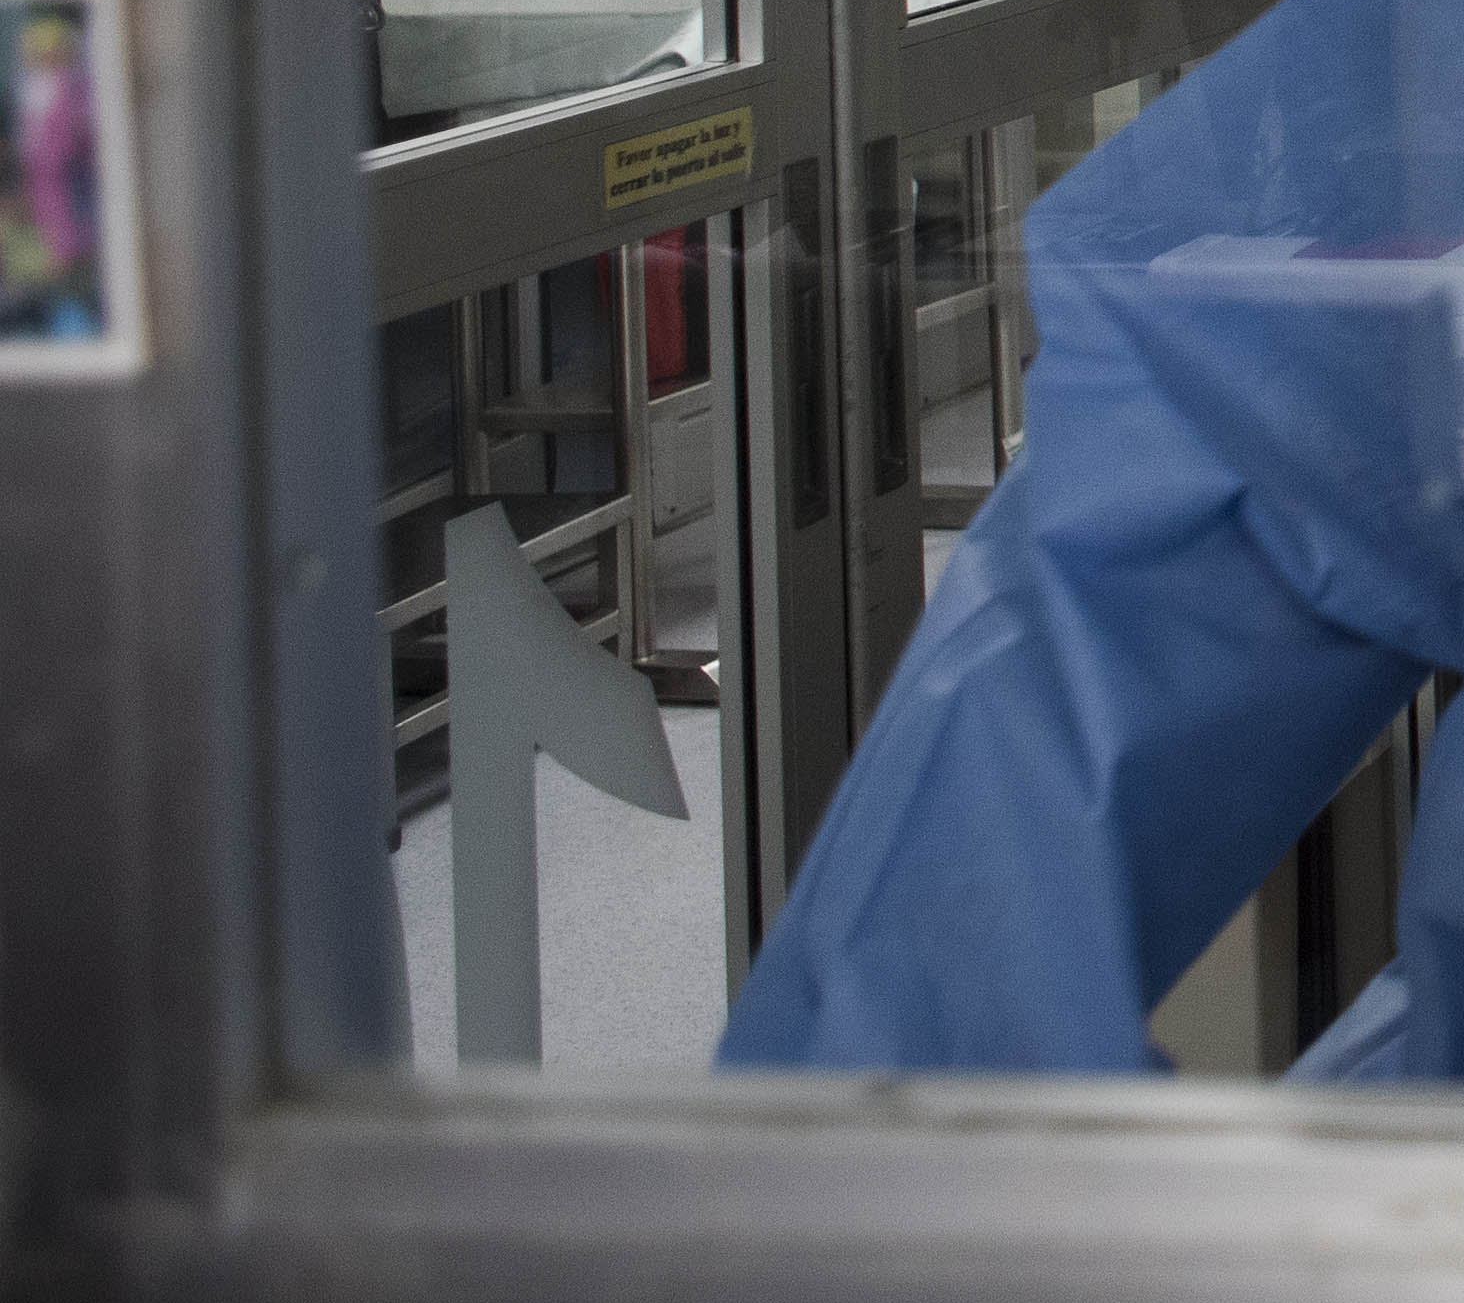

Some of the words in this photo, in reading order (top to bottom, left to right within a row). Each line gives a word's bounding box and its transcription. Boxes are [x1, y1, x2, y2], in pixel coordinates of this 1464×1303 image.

[616, 148, 653, 168] Favor
[655, 135, 698, 161] apagar
[610, 174, 651, 197] cerrar
[666, 158, 705, 184] puerta
